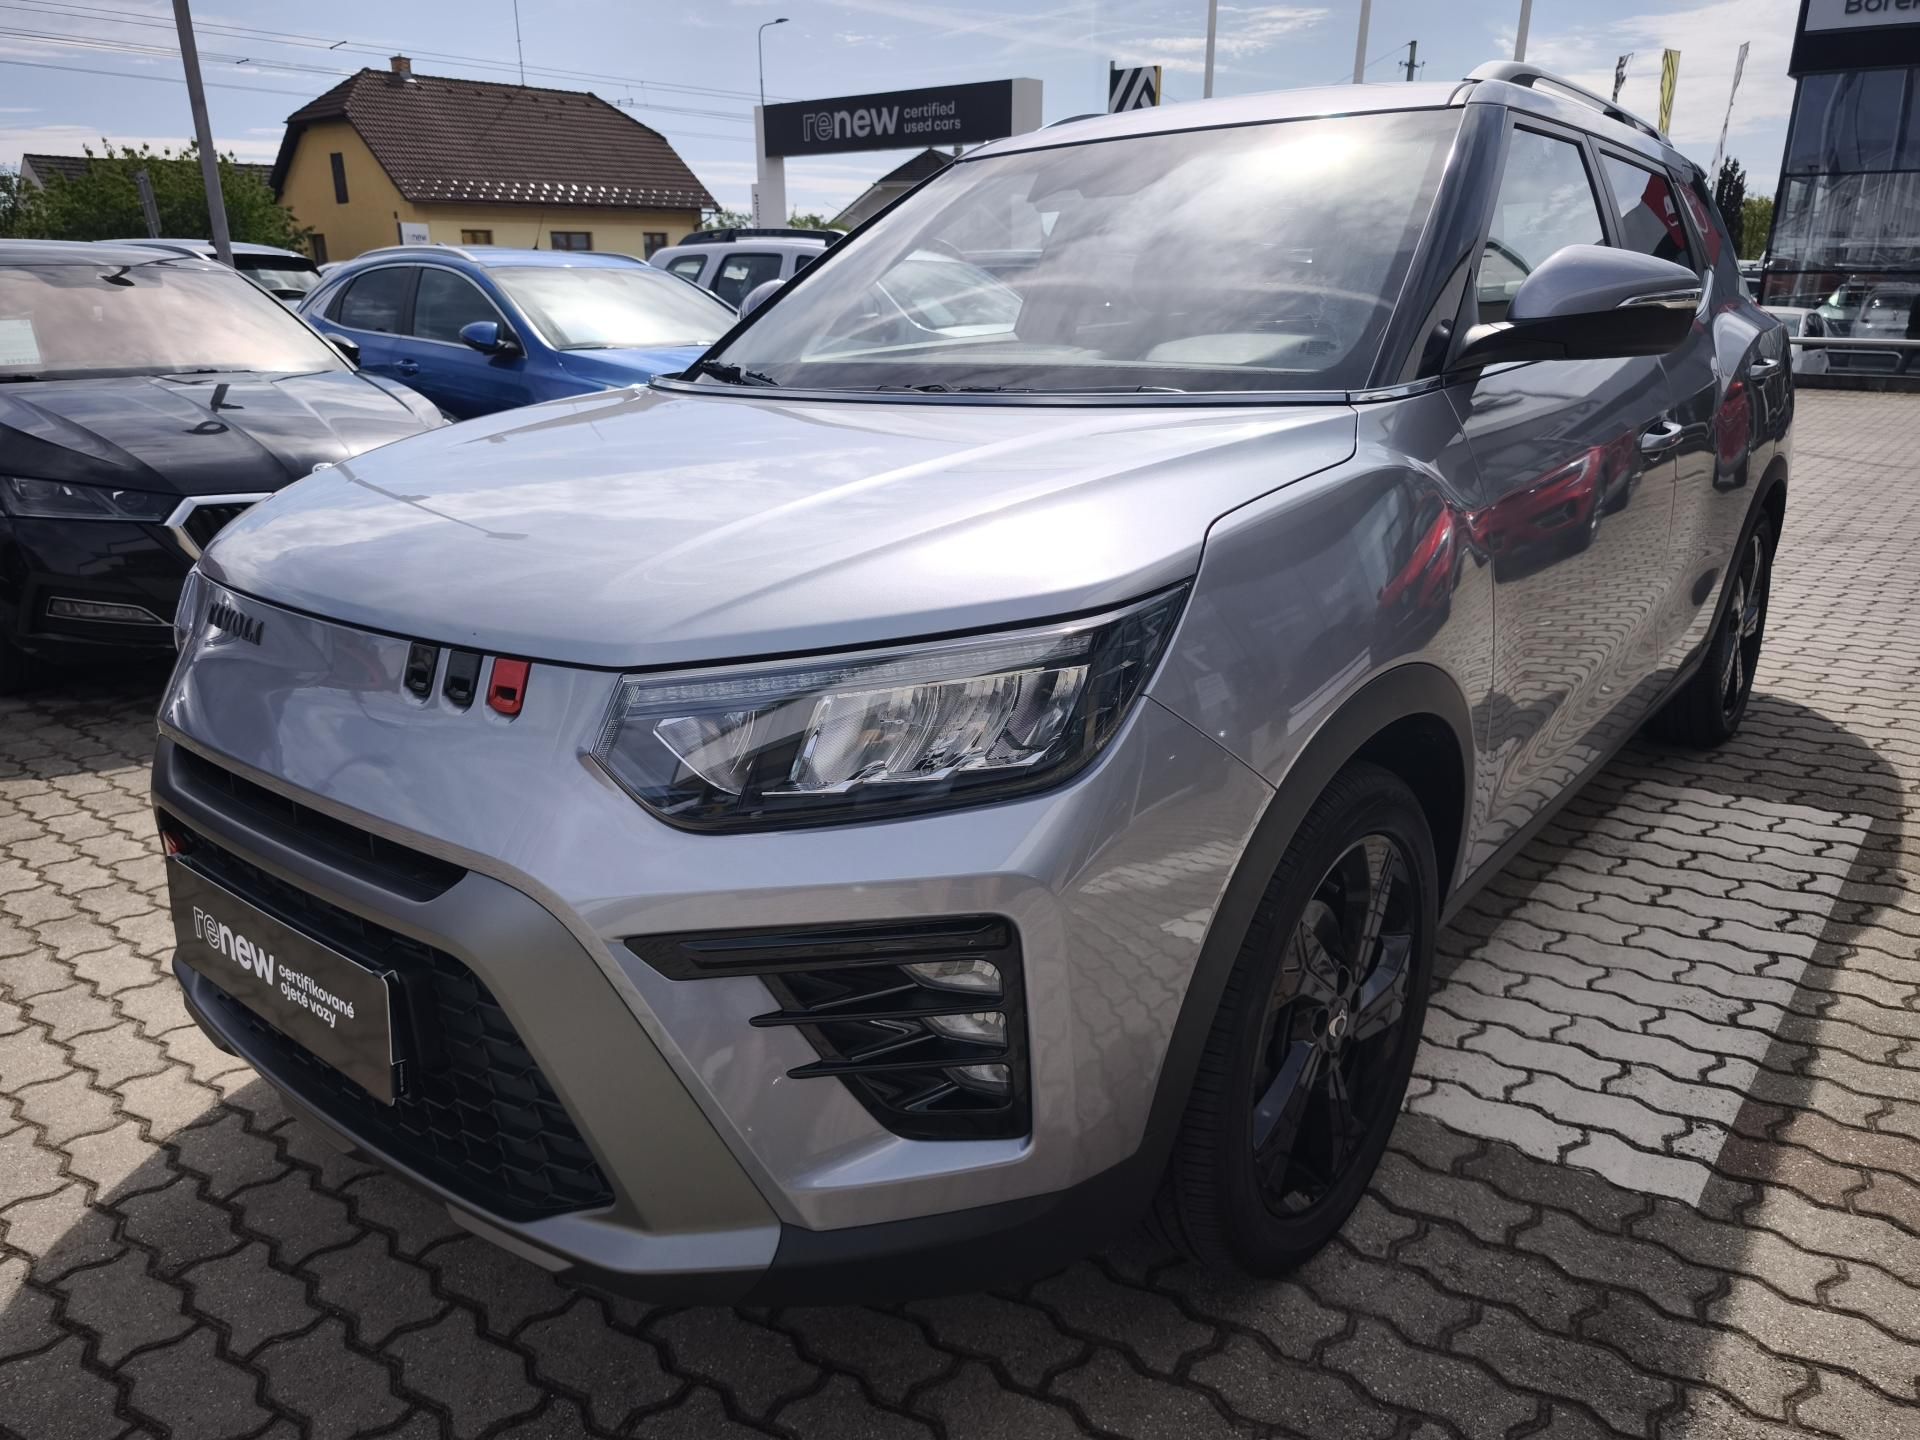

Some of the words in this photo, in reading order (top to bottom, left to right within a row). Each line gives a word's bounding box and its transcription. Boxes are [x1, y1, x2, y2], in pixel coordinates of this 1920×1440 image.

[803, 106, 899, 142] renew
[904, 101, 955, 118] certified
[904, 119, 932, 133] used
[934, 117, 961, 131] cars
[193, 906, 274, 985] renew
[279, 965, 354, 1018] certifikované
[281, 982, 308, 1007] ojeté
[310, 999, 336, 1028] vozy
